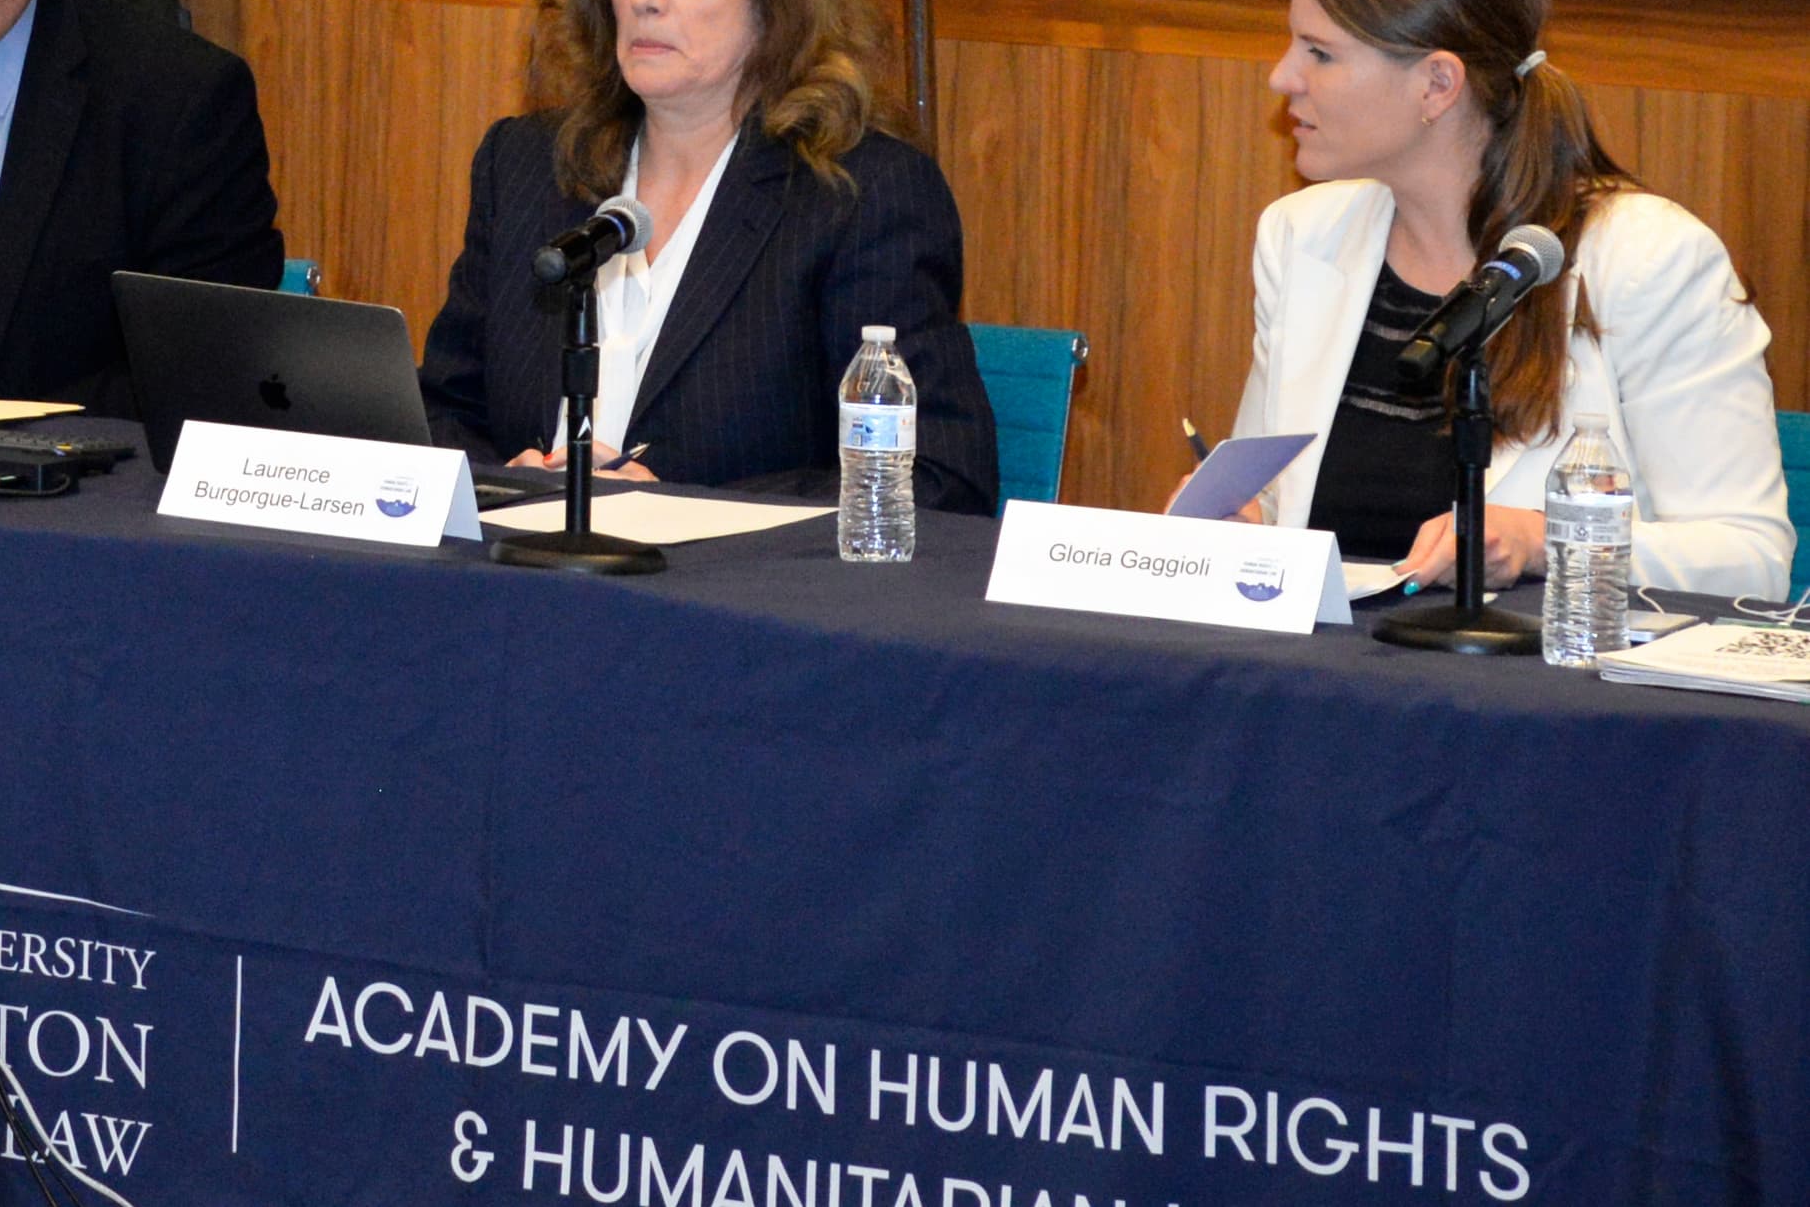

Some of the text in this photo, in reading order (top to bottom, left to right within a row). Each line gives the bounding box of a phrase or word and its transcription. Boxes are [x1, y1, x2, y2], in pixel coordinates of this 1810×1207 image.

[242, 457, 331, 484] Laurence
[194, 480, 365, 516] Burgorgue-Larsen
[1048, 543, 1112, 567] Gloria
[1120, 549, 1211, 578] Gaggioli
[304, 975, 1530, 1201] ACADEMY ON HUMAN RIGHTS
[0, 1094, 154, 1176] LAW
[450, 1110, 495, 1183] &
